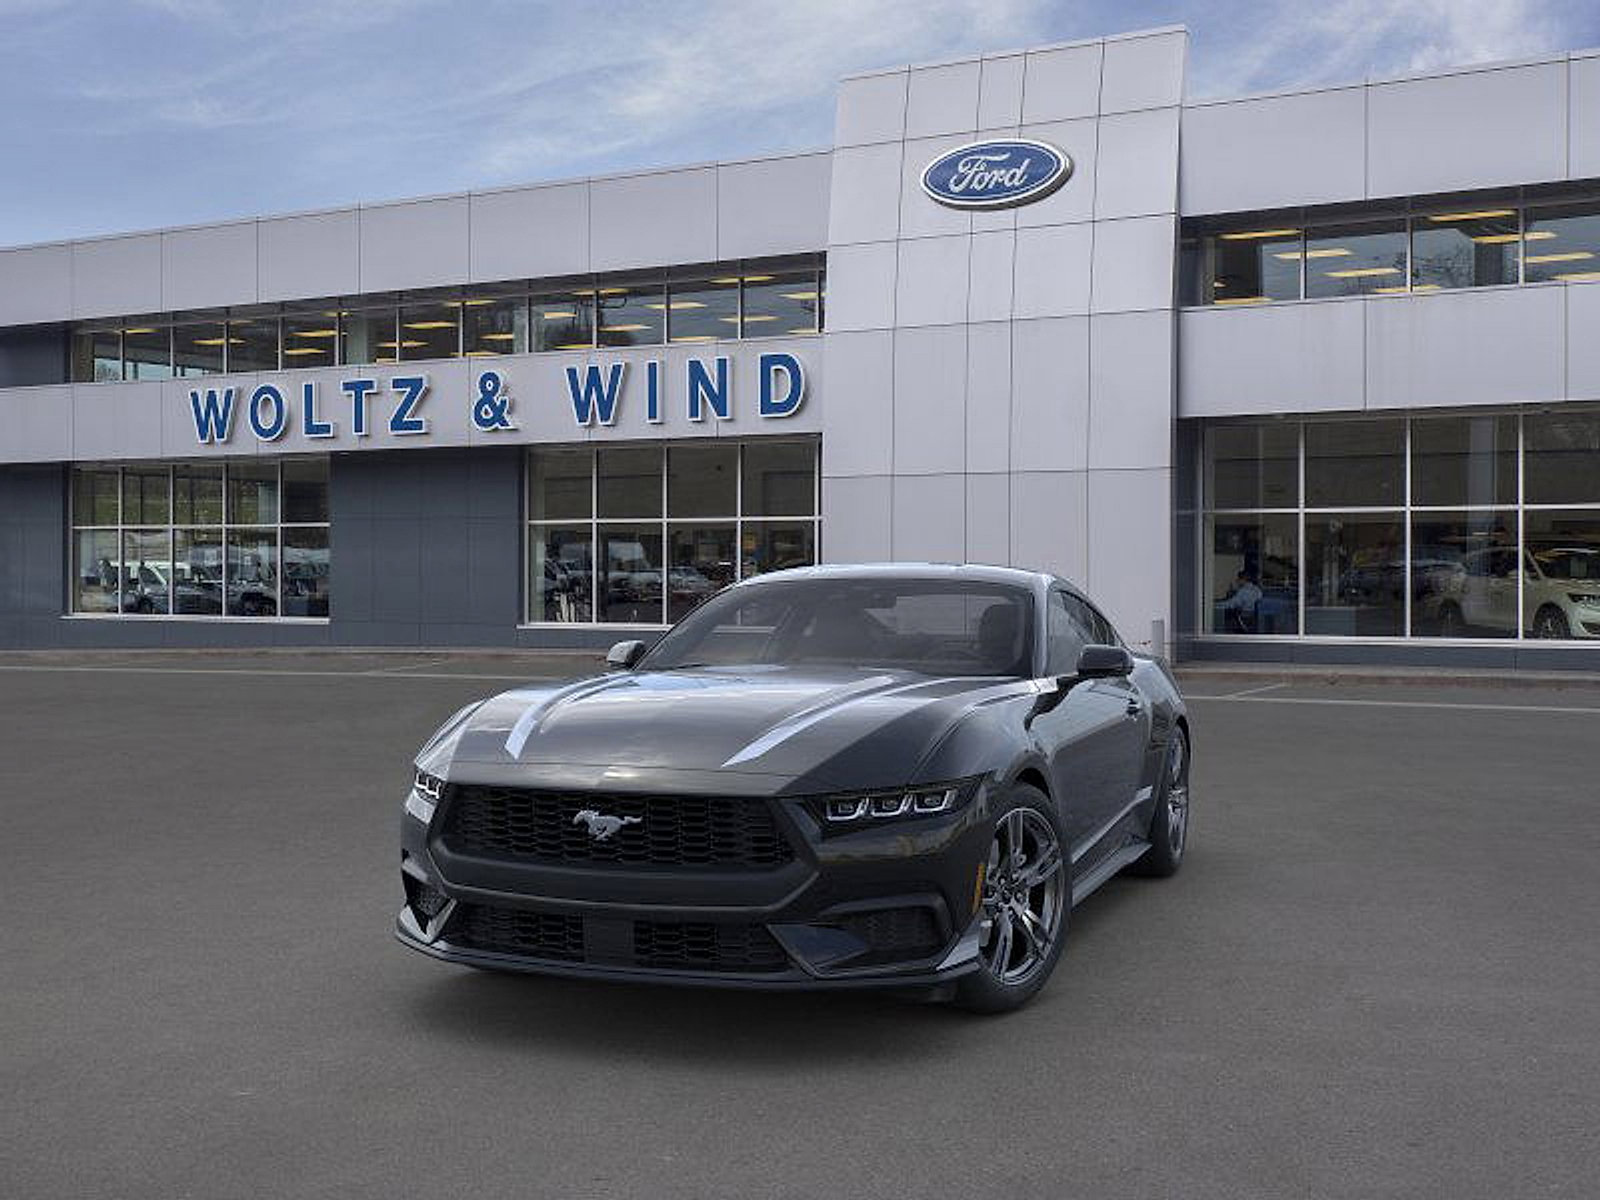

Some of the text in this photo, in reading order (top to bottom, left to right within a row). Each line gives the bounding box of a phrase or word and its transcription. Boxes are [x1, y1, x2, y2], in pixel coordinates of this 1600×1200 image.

[949, 152, 1031, 193] Ford
[190, 352, 806, 443] WOLTZ & WIND
